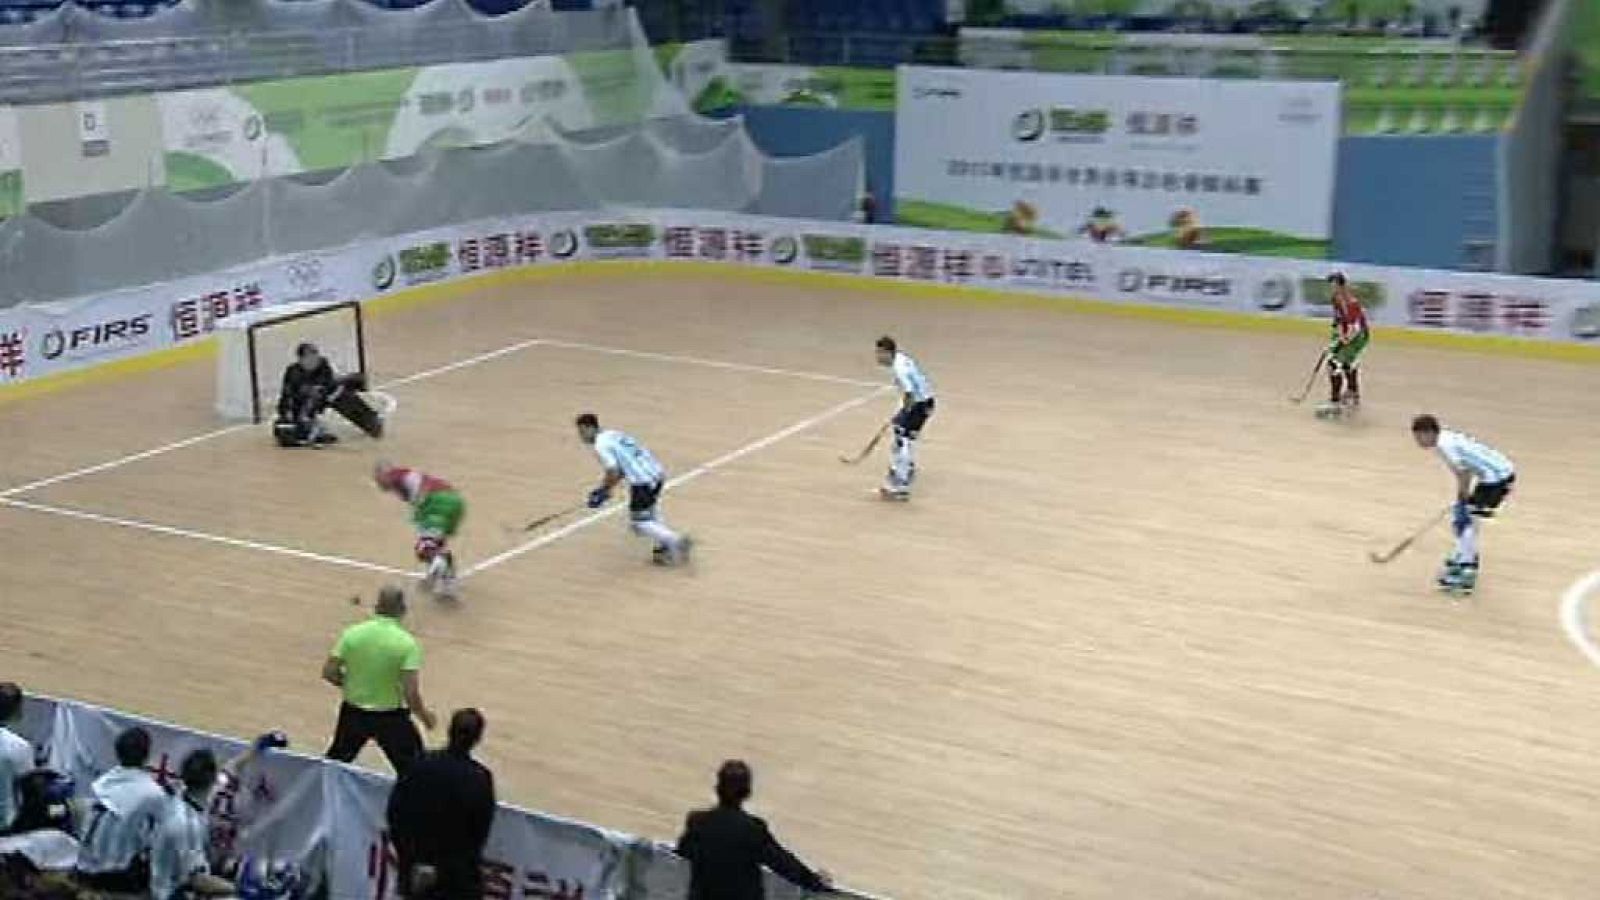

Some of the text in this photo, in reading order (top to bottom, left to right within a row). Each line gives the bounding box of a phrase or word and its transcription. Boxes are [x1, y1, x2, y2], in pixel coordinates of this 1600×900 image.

[457, 230, 543, 272] 恒源祥
[70, 313, 153, 350] FIRS
[171, 281, 263, 342] 恒源祥
